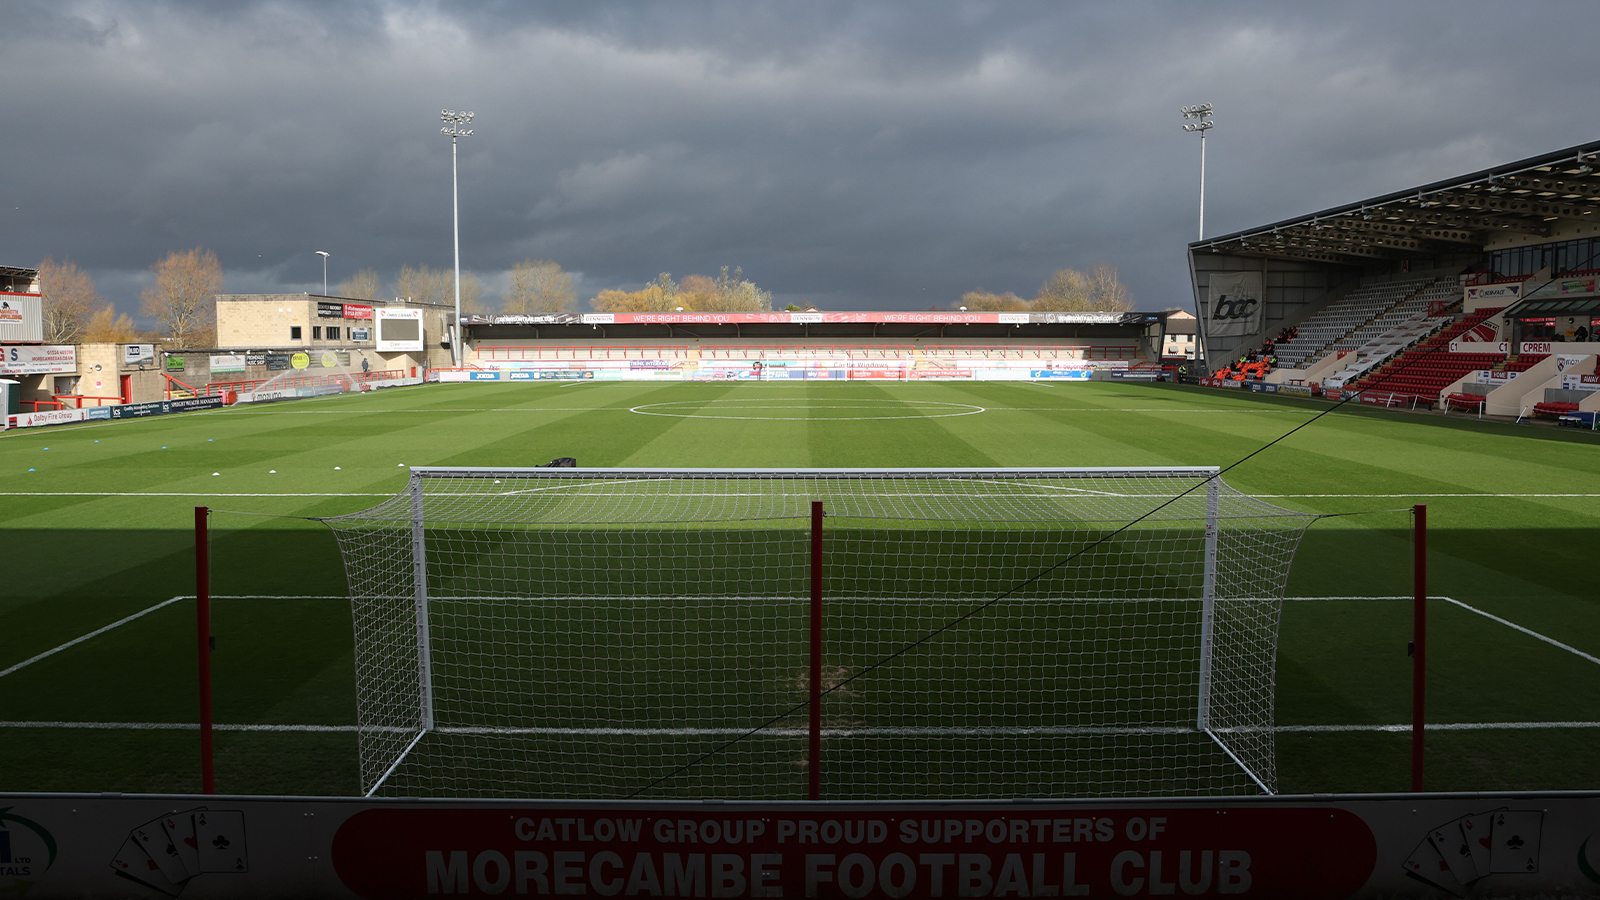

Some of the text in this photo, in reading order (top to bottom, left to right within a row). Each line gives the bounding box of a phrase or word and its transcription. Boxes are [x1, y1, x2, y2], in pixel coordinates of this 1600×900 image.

[1401, 260, 1408, 272] A
[1212, 295, 1257, 320] bcc
[1450, 343, 1458, 351] C1
[1499, 343, 1507, 352] C1
[1523, 343, 1551, 352] CPREM
[11, 348, 18, 361] S
[515, 817, 1167, 844] CATLOW GROUP PROUD SUPPORTERS OF
[425, 849, 1253, 898] MORECAMBE FOOTBALL CLUB
